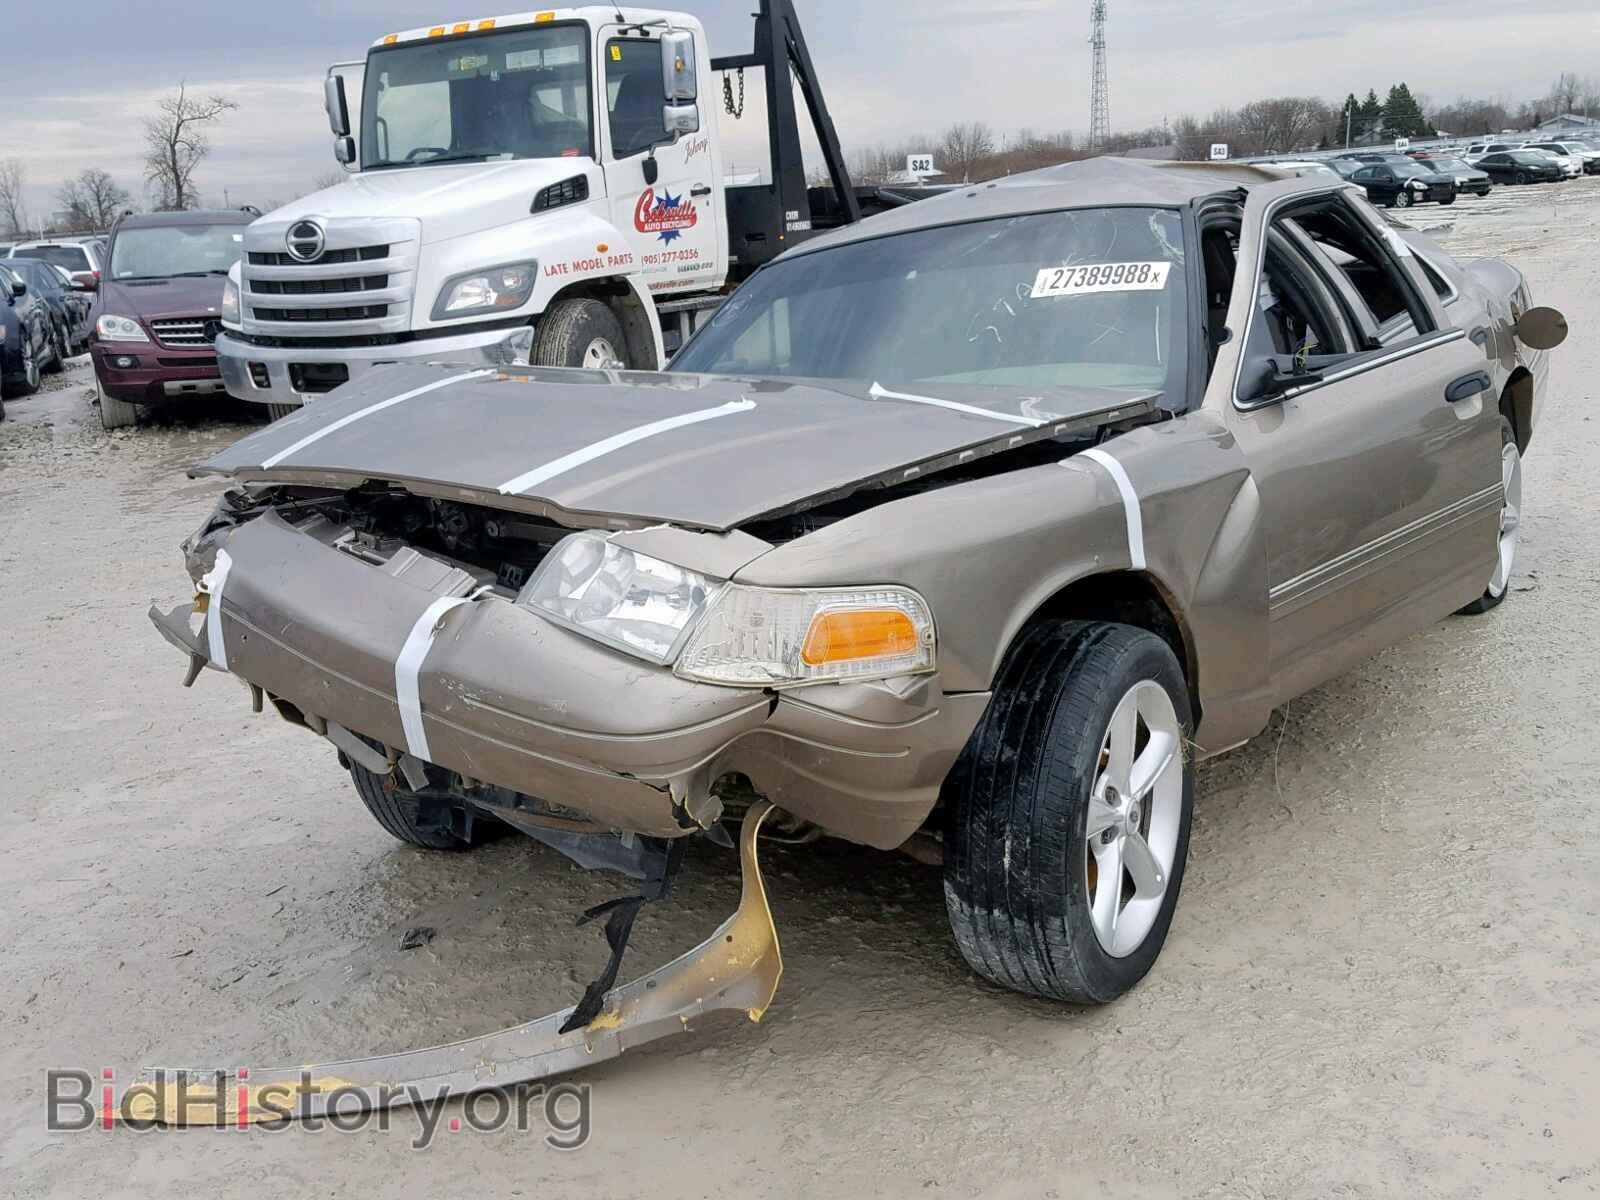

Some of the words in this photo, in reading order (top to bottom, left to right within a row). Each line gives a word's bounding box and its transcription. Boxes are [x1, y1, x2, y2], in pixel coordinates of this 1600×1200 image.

[912, 159, 930, 171] SA2
[645, 222, 660, 231] AUTO
[543, 263, 568, 277] LATE
[572, 257, 605, 273] MODEL
[607, 253, 633, 266] PARTS
[1049, 263, 1151, 290] 27389988
